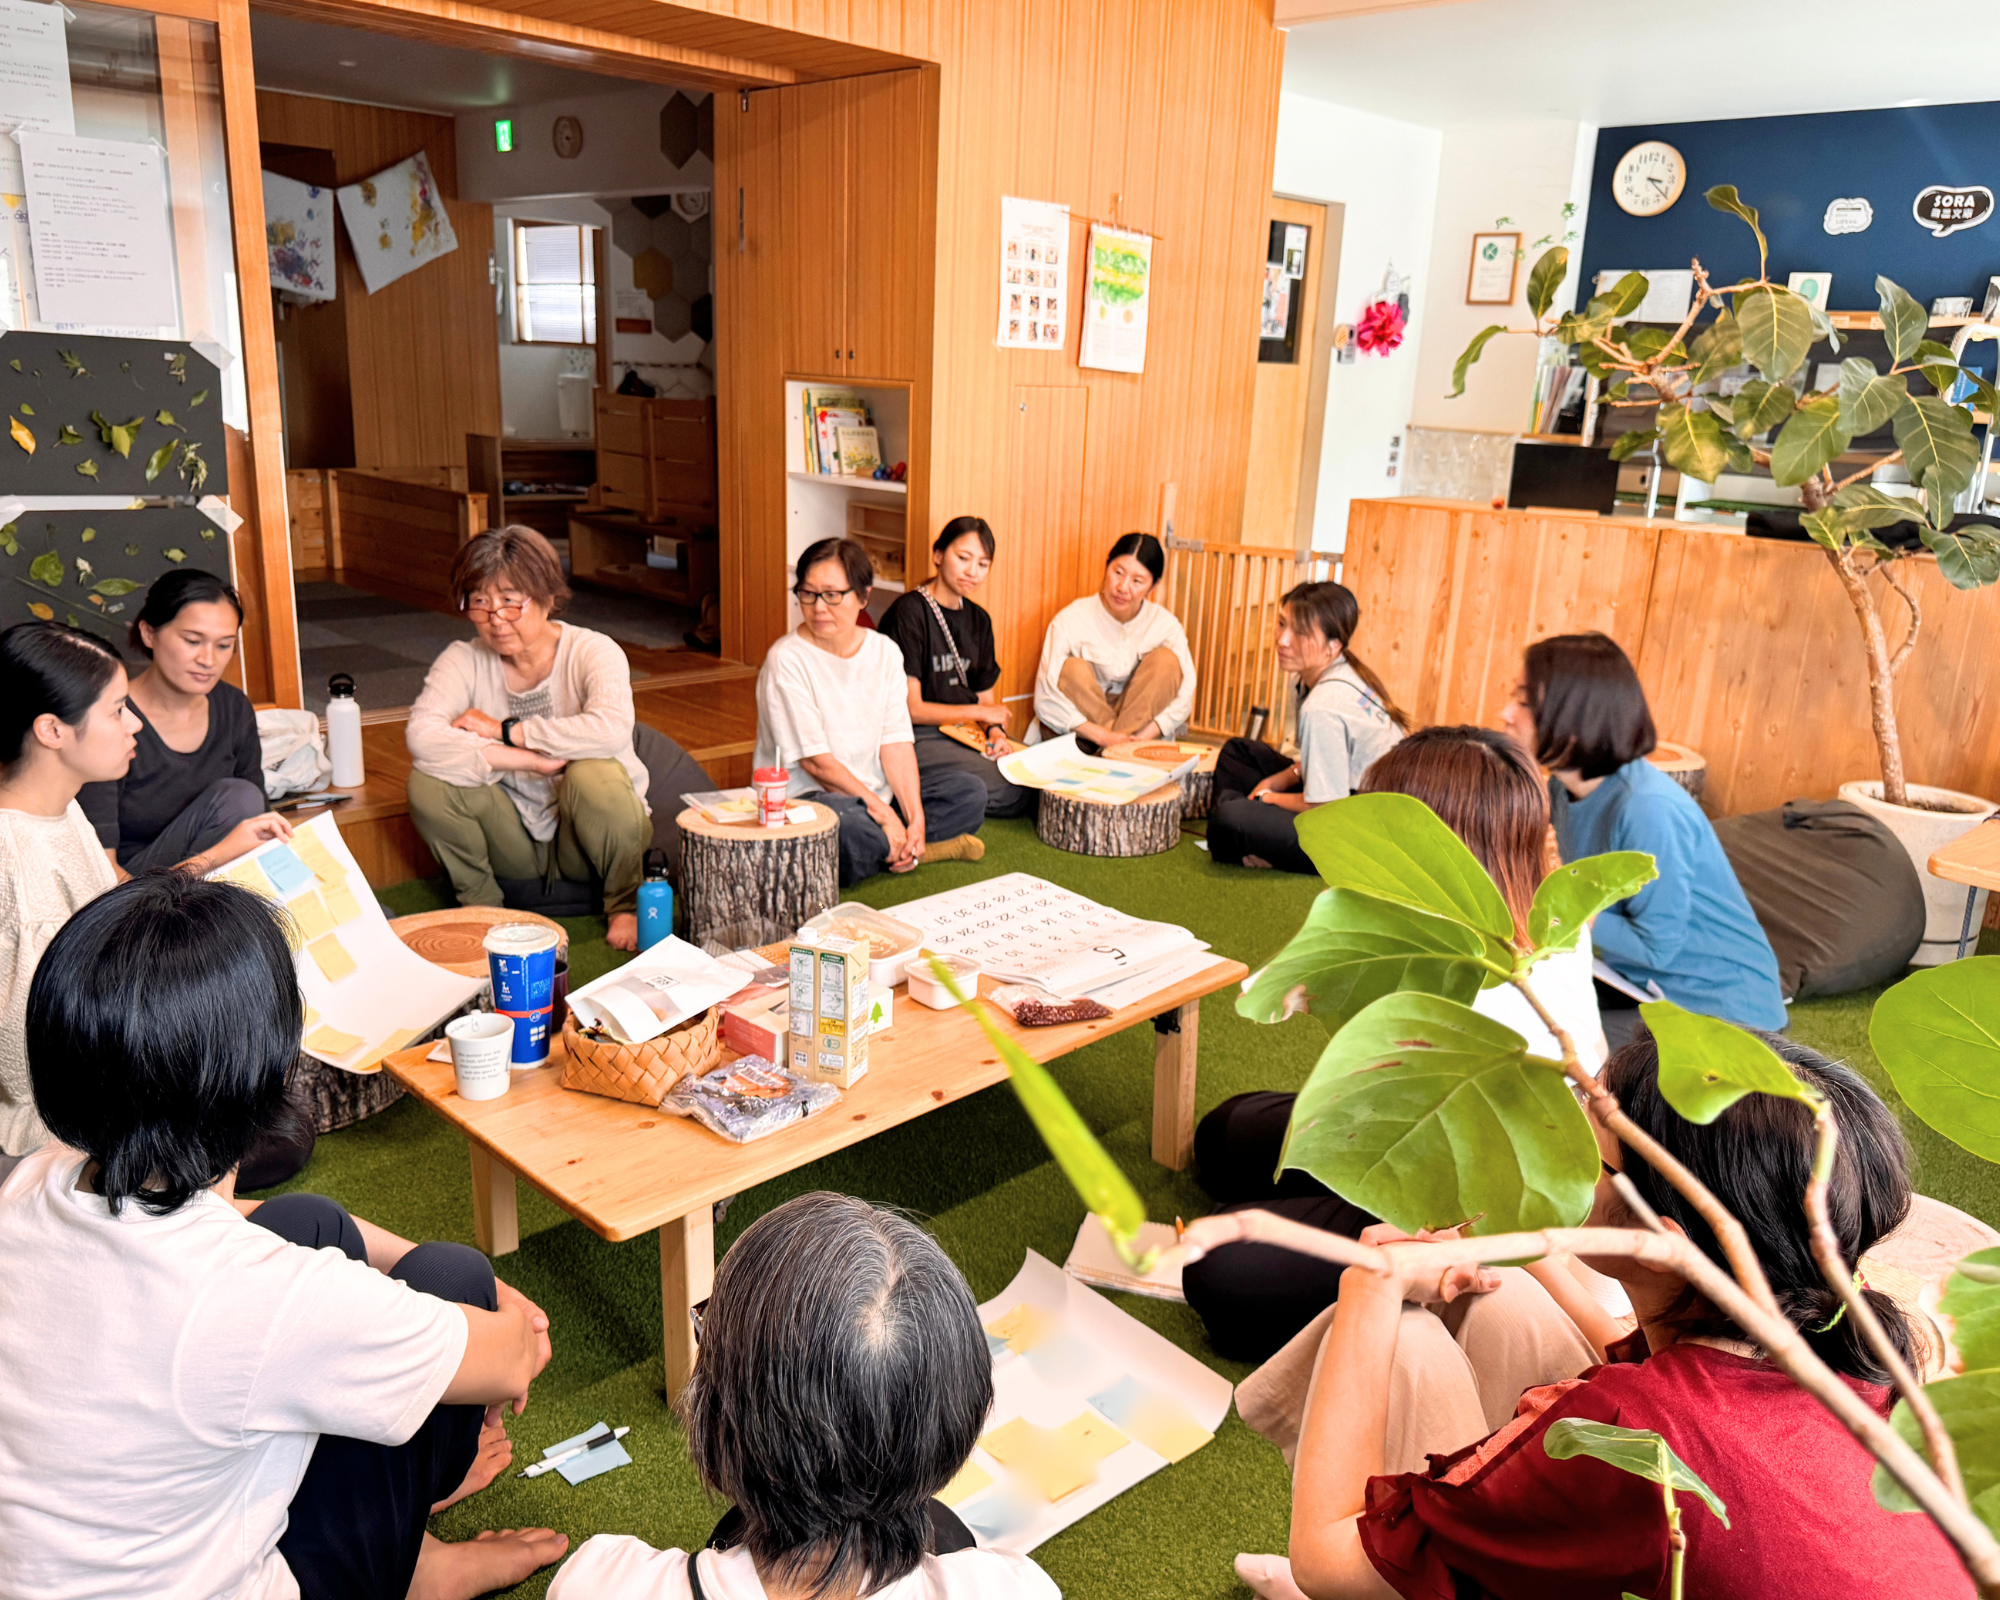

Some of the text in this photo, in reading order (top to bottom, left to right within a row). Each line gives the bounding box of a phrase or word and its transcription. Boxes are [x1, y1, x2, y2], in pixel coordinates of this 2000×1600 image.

[1933, 194, 1976, 208] SORA
[1014, 889, 1030, 897] 27
[992, 894, 1011, 903] 28
[1035, 898, 1052, 907] 20
[974, 901, 991, 910] 29
[1016, 905, 1034, 914] 21
[953, 908, 972, 918] 30
[995, 912, 1015, 921] 22
[934, 916, 952, 925] 31
[976, 920, 995, 929] 23
[956, 927, 975, 936] 24
[960, 903, 1094, 955] 12 13 14 15 16 17 18
[935, 935, 954, 945] 25
[1005, 949, 1024, 957] 10
[1093, 945, 1127, 960] 5
